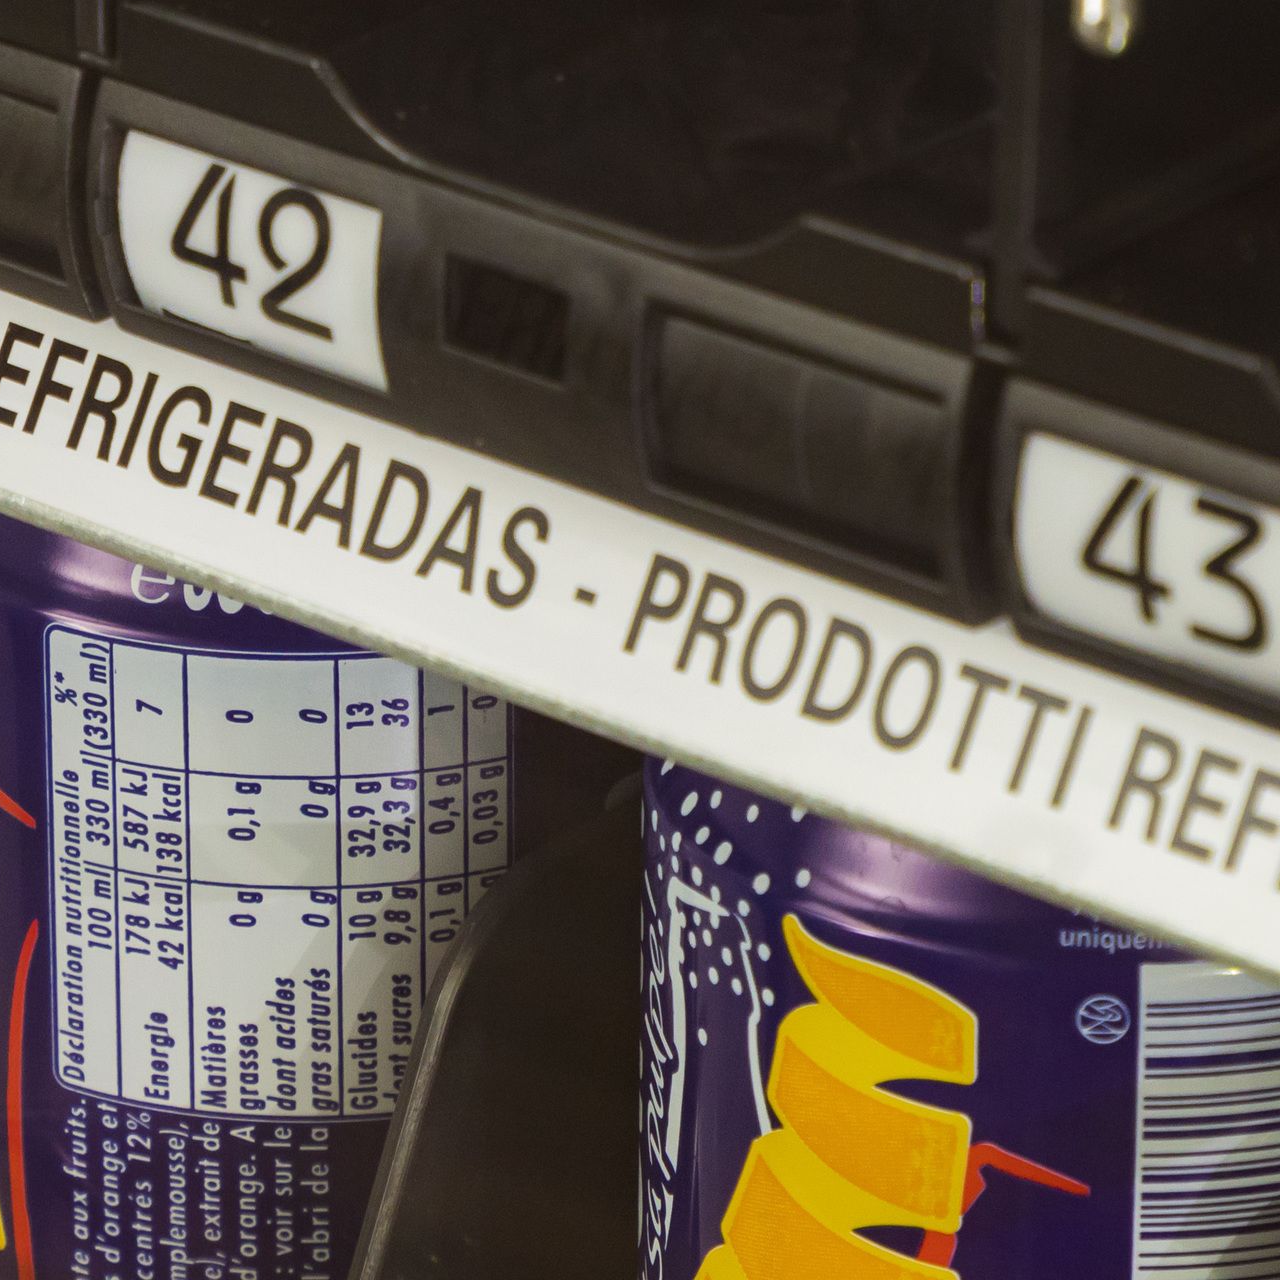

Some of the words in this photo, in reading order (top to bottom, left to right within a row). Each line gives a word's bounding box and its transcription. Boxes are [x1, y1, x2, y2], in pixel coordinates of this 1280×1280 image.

[169, 164, 335, 342] 42
[1081, 475, 1269, 653] 43
[81, 642, 110, 683] ml)
[621, 554, 1096, 810] PRODOTTI
[82, 693, 110, 750] (330
[136, 700, 162, 715] 7
[225, 711, 253, 723] 0
[299, 710, 327, 724] 0
[345, 703, 374, 729] 13
[382, 699, 410, 727] 36
[121, 769, 148, 795] kJ
[232, 782, 261, 794] g
[304, 781, 335, 795] g
[351, 782, 381, 793] g
[385, 777, 417, 790] g
[432, 773, 461, 785] g
[475, 766, 504, 779] g
[153, 773, 182, 822] kcal
[300, 805, 328, 818] 0
[428, 797, 459, 834] 0,4
[86, 800, 110, 846] 330
[123, 806, 149, 852] 587
[227, 808, 260, 841] 0,1
[347, 806, 379, 858] 32,9
[382, 800, 415, 853] 32,3
[472, 790, 503, 844] 0,03
[55, 770, 82, 936] nutritionnelle
[156, 833, 182, 874] 138
[124, 879, 150, 904] kJ
[156, 883, 183, 930] kcal
[234, 891, 263, 904] g
[306, 890, 335, 904] g
[353, 891, 382, 904] g
[387, 886, 418, 899] g
[434, 882, 462, 894] g
[87, 909, 112, 951] 100
[126, 916, 150, 955] 178
[229, 915, 257, 927] 0
[302, 915, 329, 927] 0
[348, 915, 377, 940] 10
[384, 911, 417, 945] 9,8
[429, 908, 461, 943] 0,1
[159, 940, 184, 969] 42
[58, 947, 85, 1082] Déclaration
[264, 977, 294, 1050] acides
[298, 968, 332, 1053] saturés
[387, 974, 412, 1045] sucres
[144, 1012, 175, 1100] Energie
[201, 1006, 227, 1108] Matières
[235, 1024, 264, 1111] grasses
[350, 1011, 379, 1110] Glucides
[267, 1058, 296, 1111] dont
[306, 1061, 339, 1111] gras
[98, 1103, 118, 1129] et
[63, 1098, 88, 1179] fruits.
[126, 1113, 151, 1162] 12%
[193, 1122, 220, 1151] de
[264, 1127, 292, 1147] le
[301, 1128, 329, 1150] la
[272, 1160, 293, 1196] sur
[301, 1164, 329, 1194] de
[73, 1191, 88, 1240] aux
[95, 1141, 125, 1262] d'orange
[195, 1160, 221, 1241] extrait
[267, 1208, 293, 1255] voir
